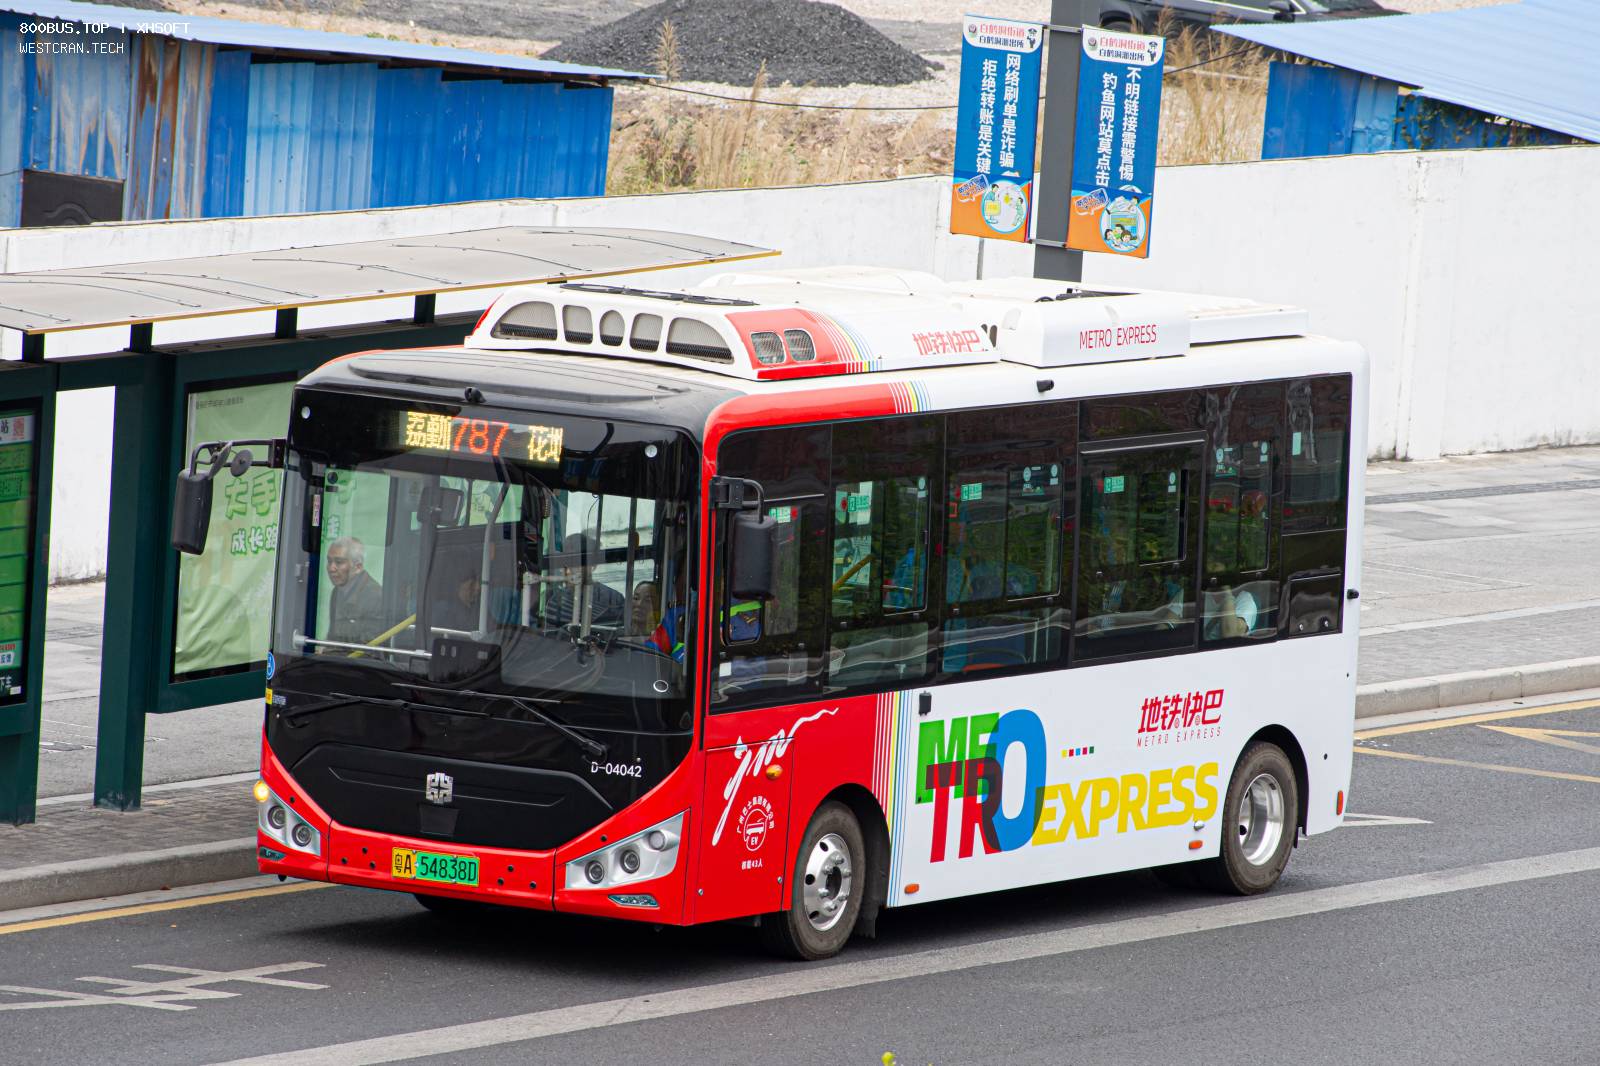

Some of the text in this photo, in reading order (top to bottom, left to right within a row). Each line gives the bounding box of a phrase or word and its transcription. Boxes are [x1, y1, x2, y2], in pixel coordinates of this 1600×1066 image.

[976, 59, 998, 174] 拒绝转账是关键
[999, 53, 1022, 168] 网络刷单是诈骗
[1095, 72, 1118, 187] 钓鱼网站莫点击
[1119, 67, 1142, 181] 不明链接需警惕
[913, 329, 981, 355] 地铁快巴
[1079, 324, 1157, 350] METRO EXPRESS
[451, 416, 509, 457] 787
[1137, 688, 1224, 733] 地铁快巴
[1137, 726, 1221, 748] METRO EXPRESS
[591, 761, 642, 778] D-04042
[1031, 761, 1219, 848] EXPRESS
